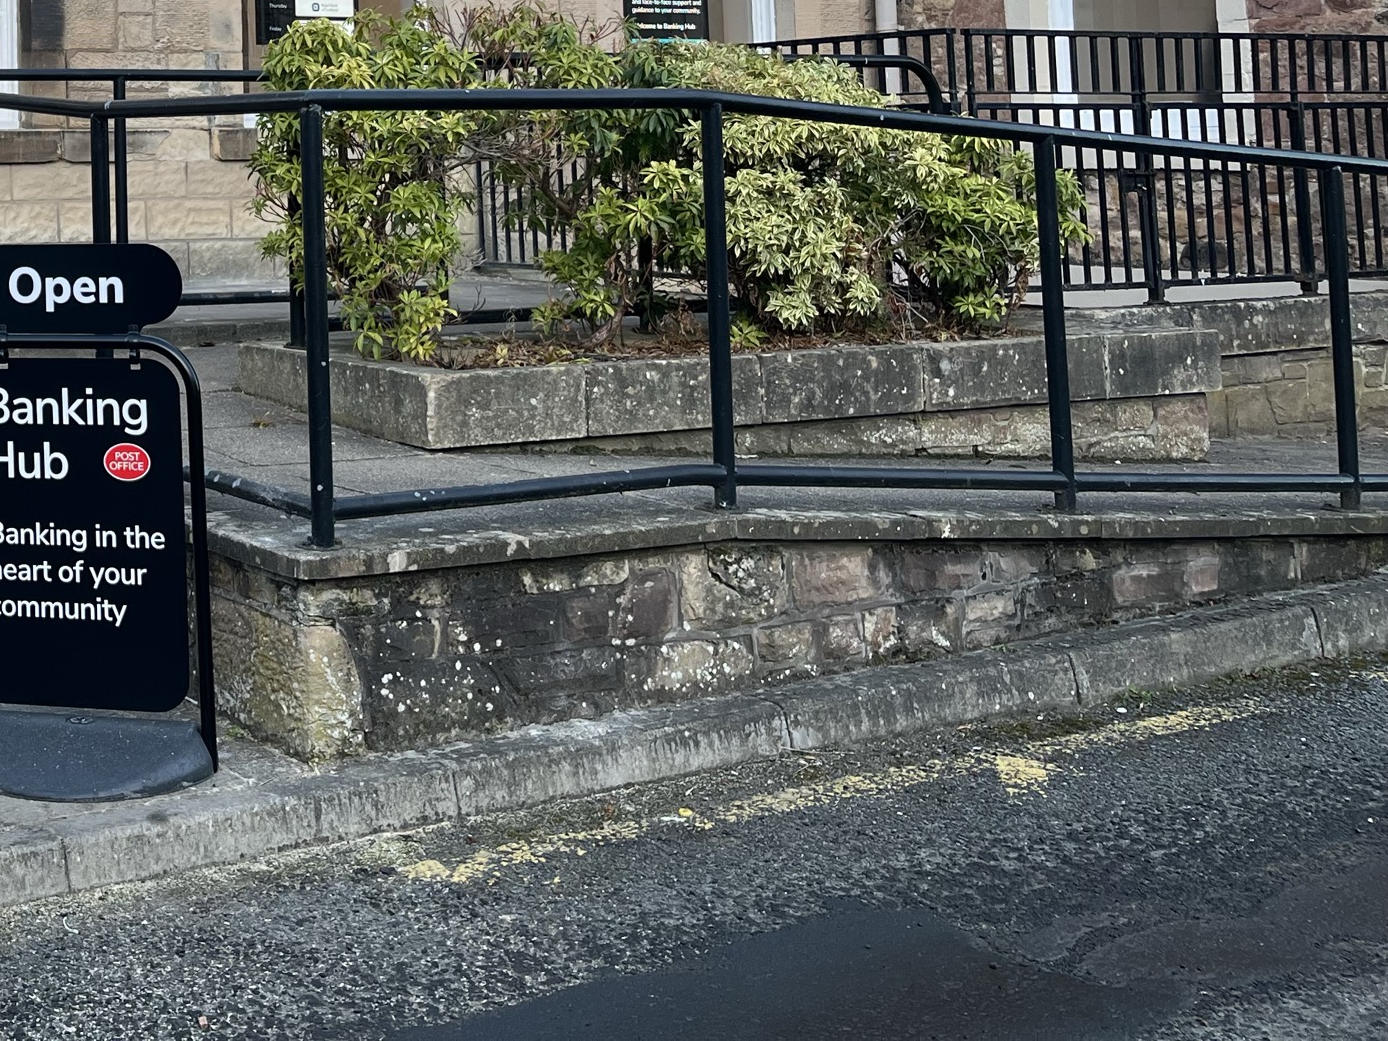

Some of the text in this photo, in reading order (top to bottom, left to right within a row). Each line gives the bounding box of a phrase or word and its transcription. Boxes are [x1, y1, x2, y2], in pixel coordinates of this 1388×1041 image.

[8, 266, 124, 312] Open
[109, 461, 144, 471] OFFICE
[115, 452, 140, 461] POST
[95, 523, 116, 549] in
[123, 525, 166, 549] the
[58, 559, 82, 583] of
[89, 565, 147, 589] your
